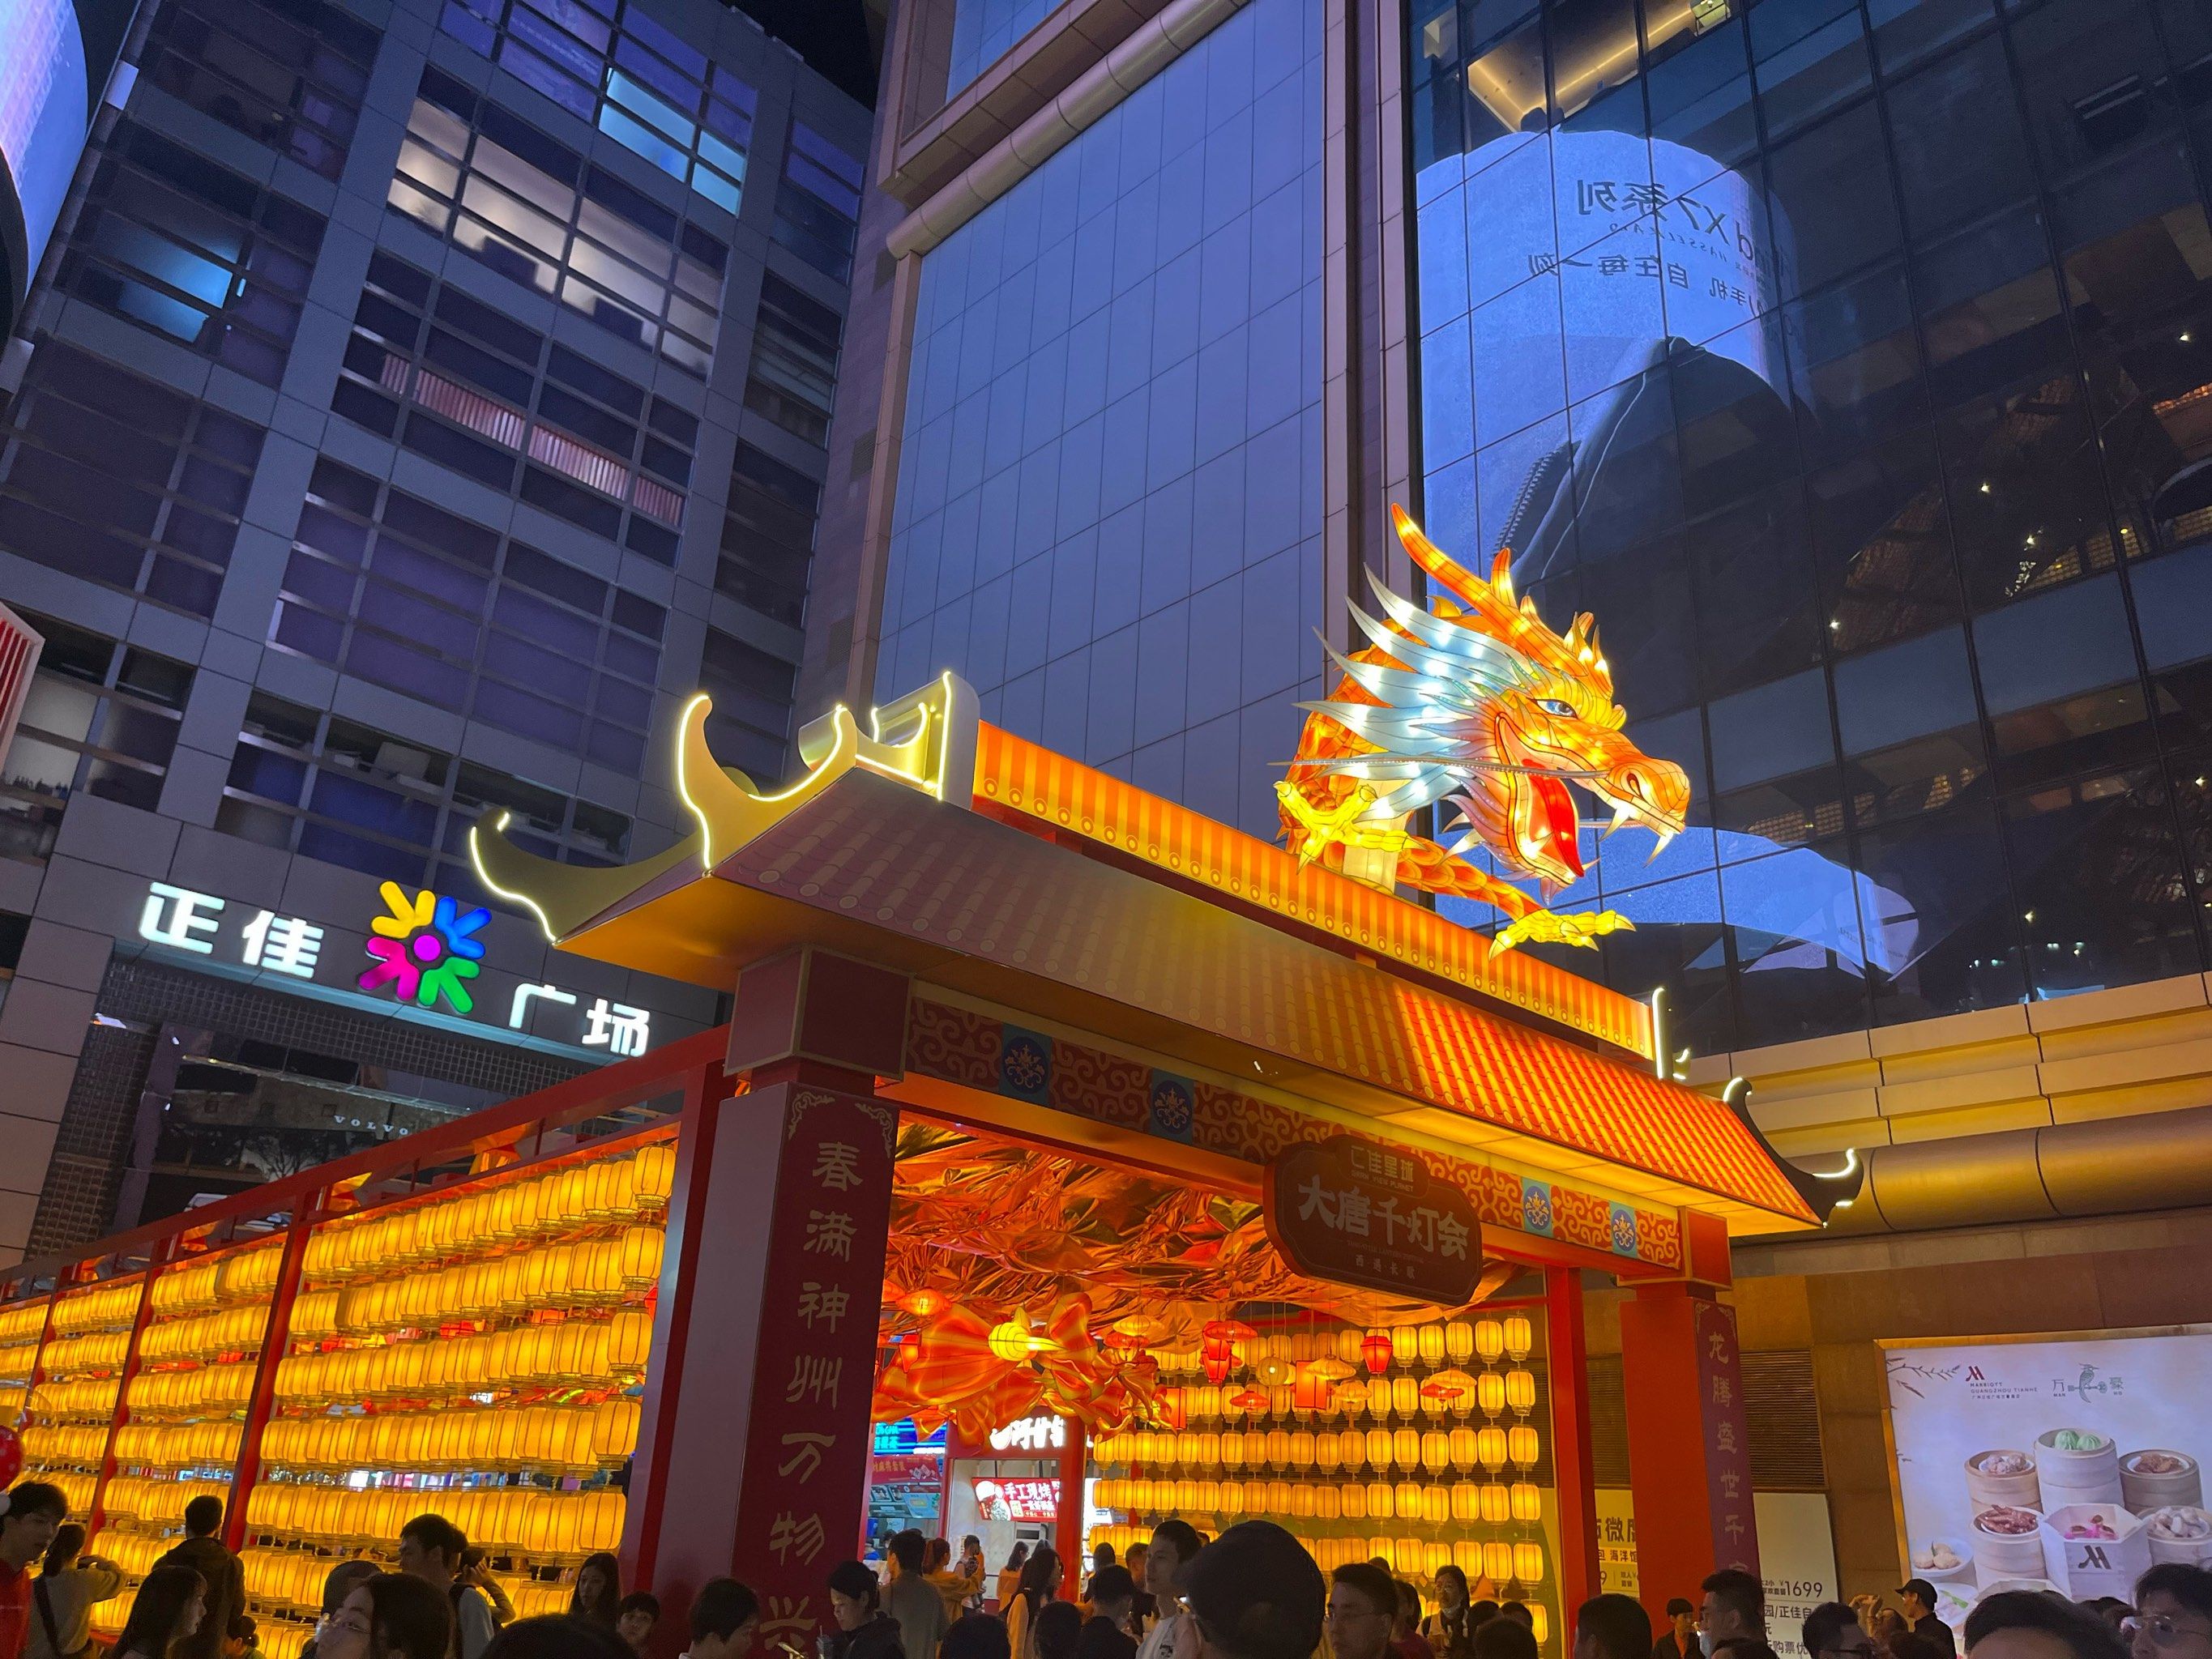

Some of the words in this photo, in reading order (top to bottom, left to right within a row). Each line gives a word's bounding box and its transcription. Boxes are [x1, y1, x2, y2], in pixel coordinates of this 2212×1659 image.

[138, 881, 325, 979] 正佳
[508, 982, 650, 1057] 广场
[334, 1115, 408, 1135] VOLVO
[1298, 1175, 1470, 1261] 大唐千灯会
[758, 1141, 863, 1651] 春满神州万物兴
